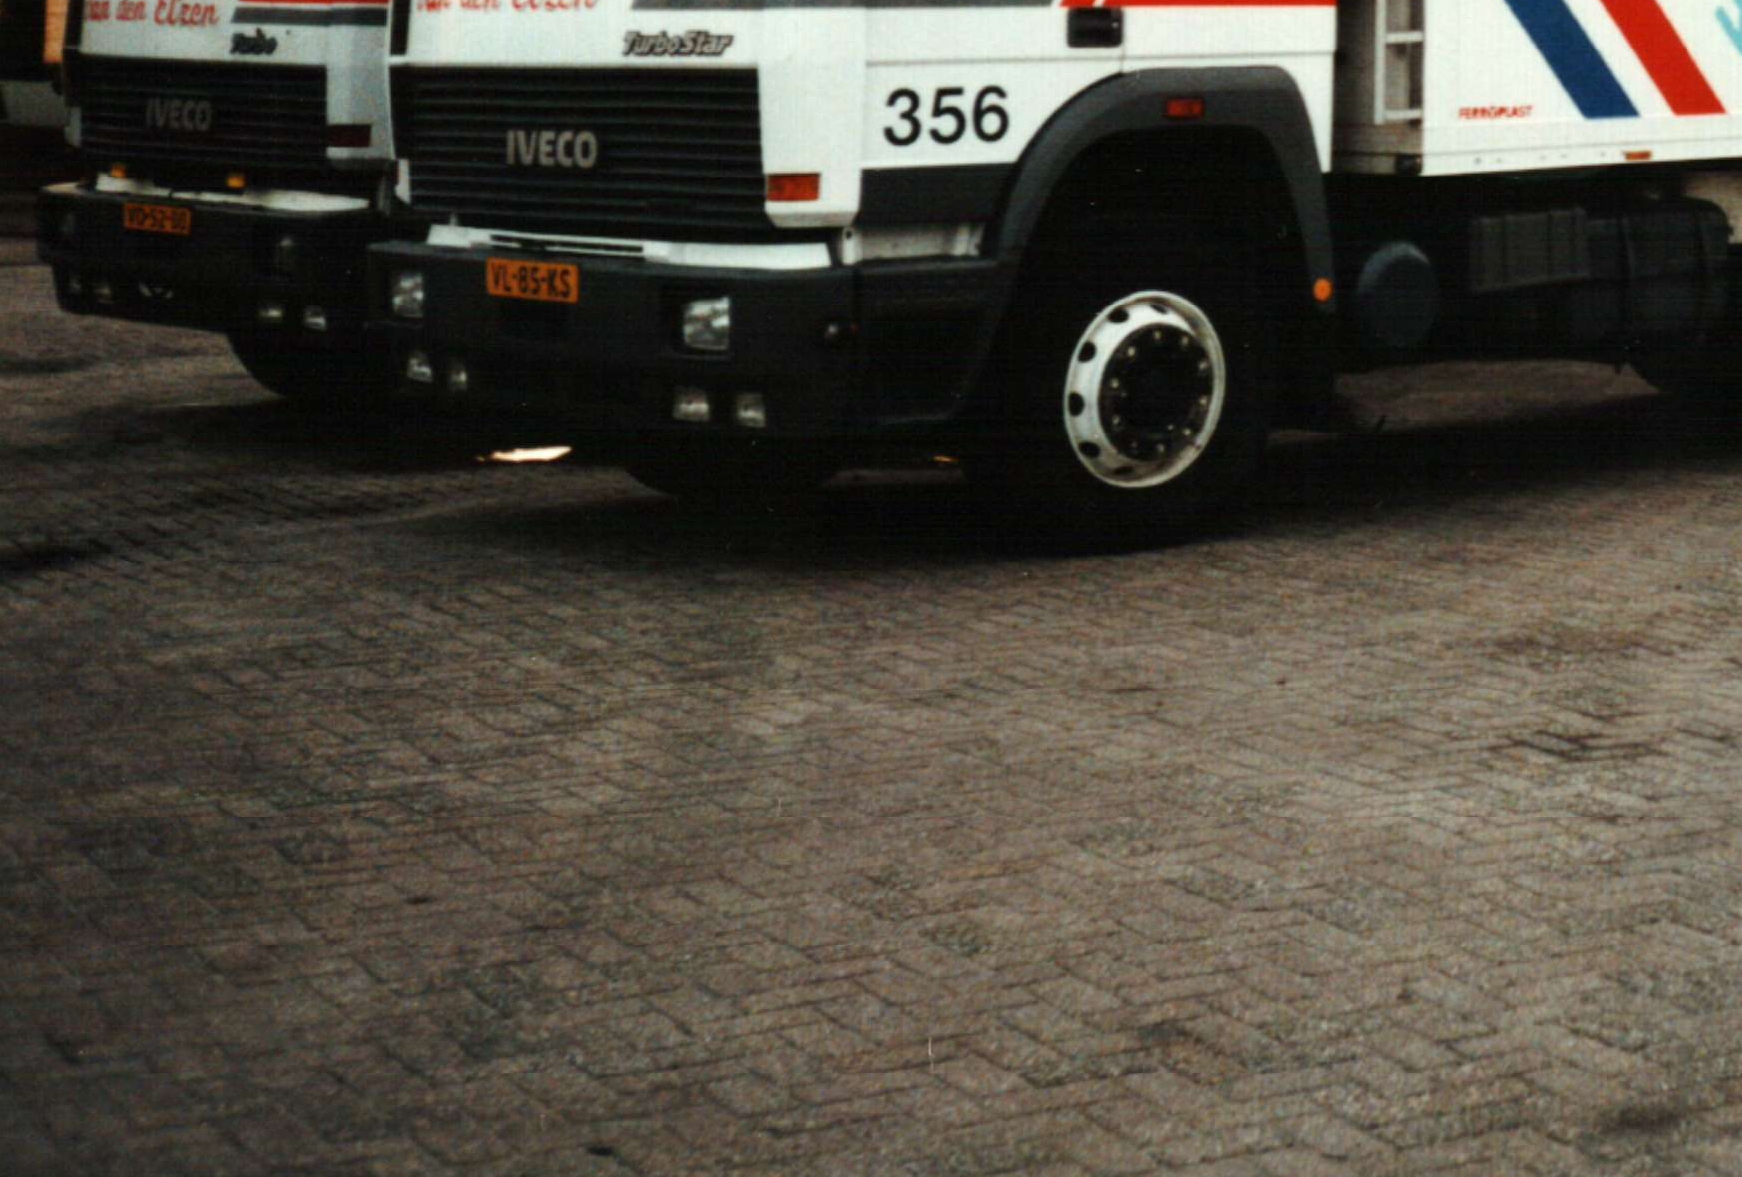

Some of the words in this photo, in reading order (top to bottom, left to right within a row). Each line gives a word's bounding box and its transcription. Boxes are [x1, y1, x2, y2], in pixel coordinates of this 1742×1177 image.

[229, 28, 278, 55] Turbo
[622, 29, 735, 57] TurboStar
[145, 98, 212, 132] IVECO
[883, 85, 1010, 147] 356
[506, 129, 598, 168] IVECO
[490, 262, 571, 298] VL-85-KS
